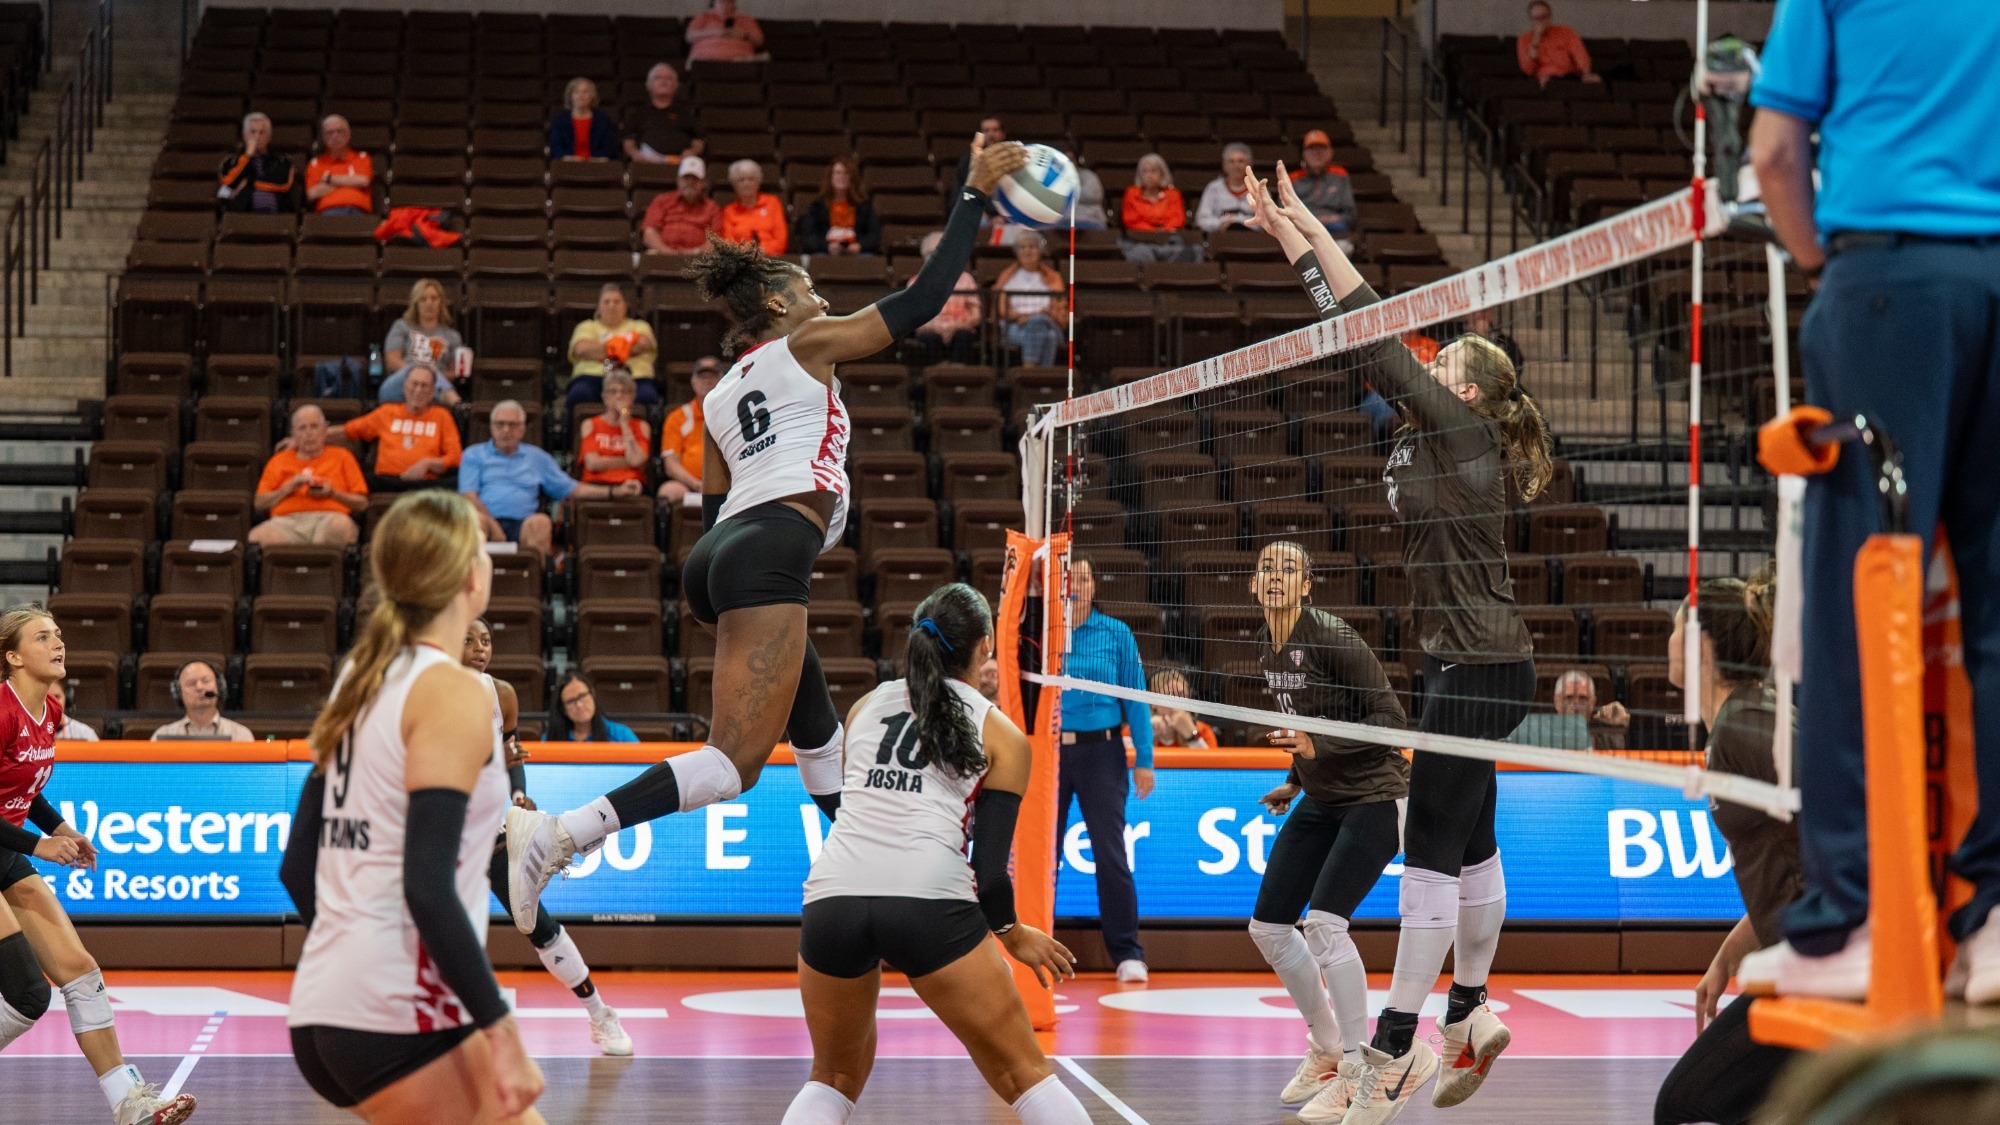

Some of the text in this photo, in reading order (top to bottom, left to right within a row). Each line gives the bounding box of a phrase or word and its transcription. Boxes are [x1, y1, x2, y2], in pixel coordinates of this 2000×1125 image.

[1302, 267, 1337, 313] AY ZIGGY
[1409, 278, 1471, 323] VOLLEYBALL
[737, 390, 771, 442] 6
[876, 711, 930, 770] 10
[28, 765, 52, 794] 11
[864, 769, 923, 793] JOSKA
[706, 803, 751, 870] E
[104, 869, 240, 900] Resorts
